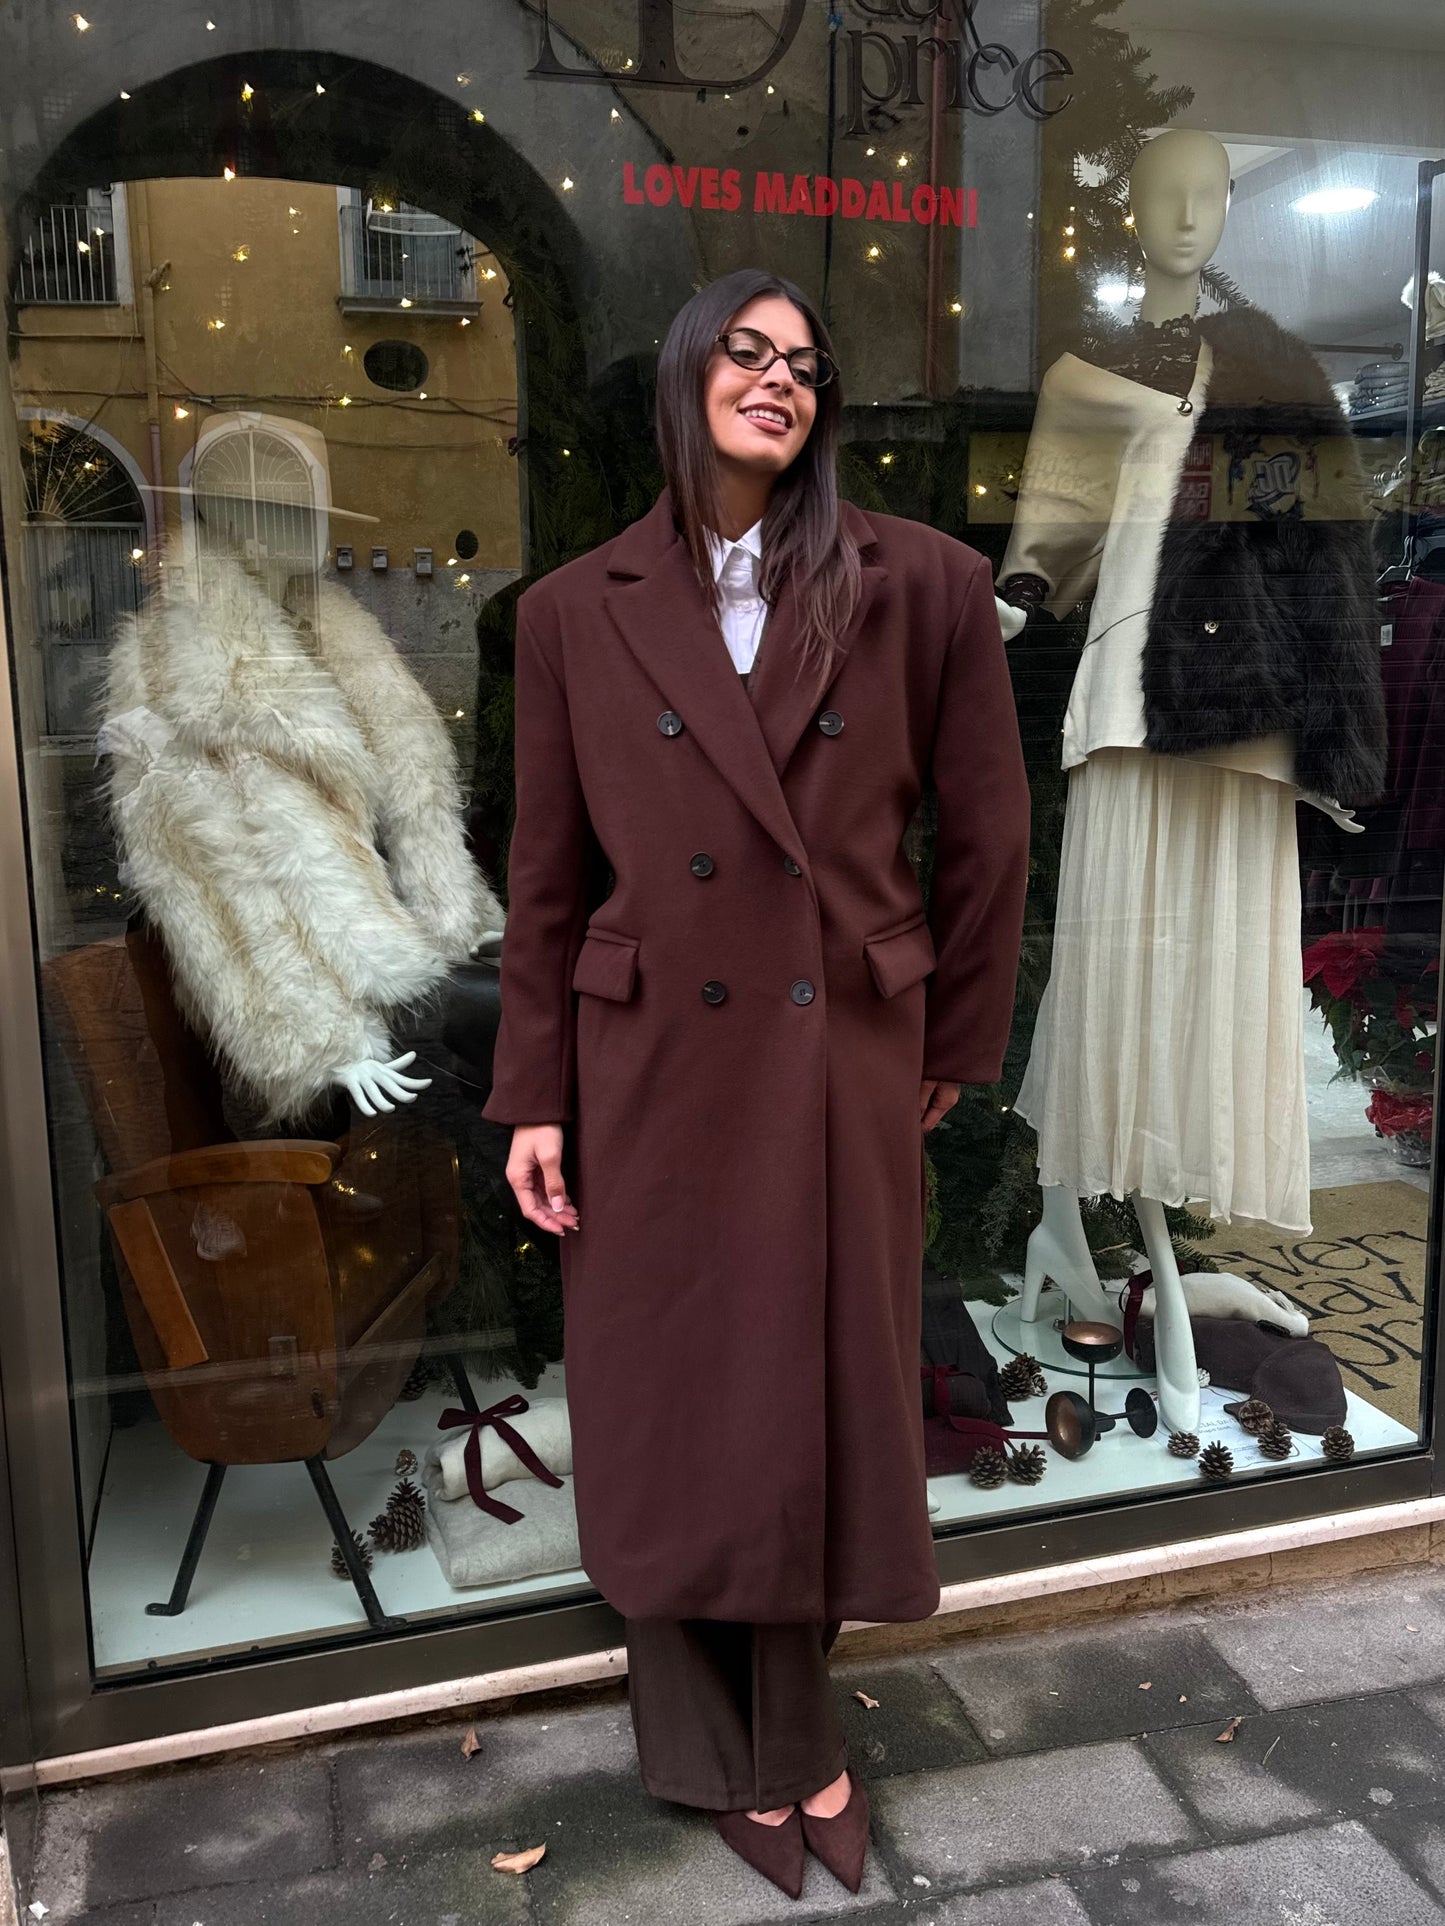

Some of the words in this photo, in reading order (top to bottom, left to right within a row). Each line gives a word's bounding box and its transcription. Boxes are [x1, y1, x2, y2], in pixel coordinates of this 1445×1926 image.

[846, 29, 1075, 136] price
[622, 162, 743, 212] LOVES
[753, 170, 979, 229] MADDALONI
[1205, 1230, 1427, 1278] ver
[1309, 1316, 1424, 1391] pr
